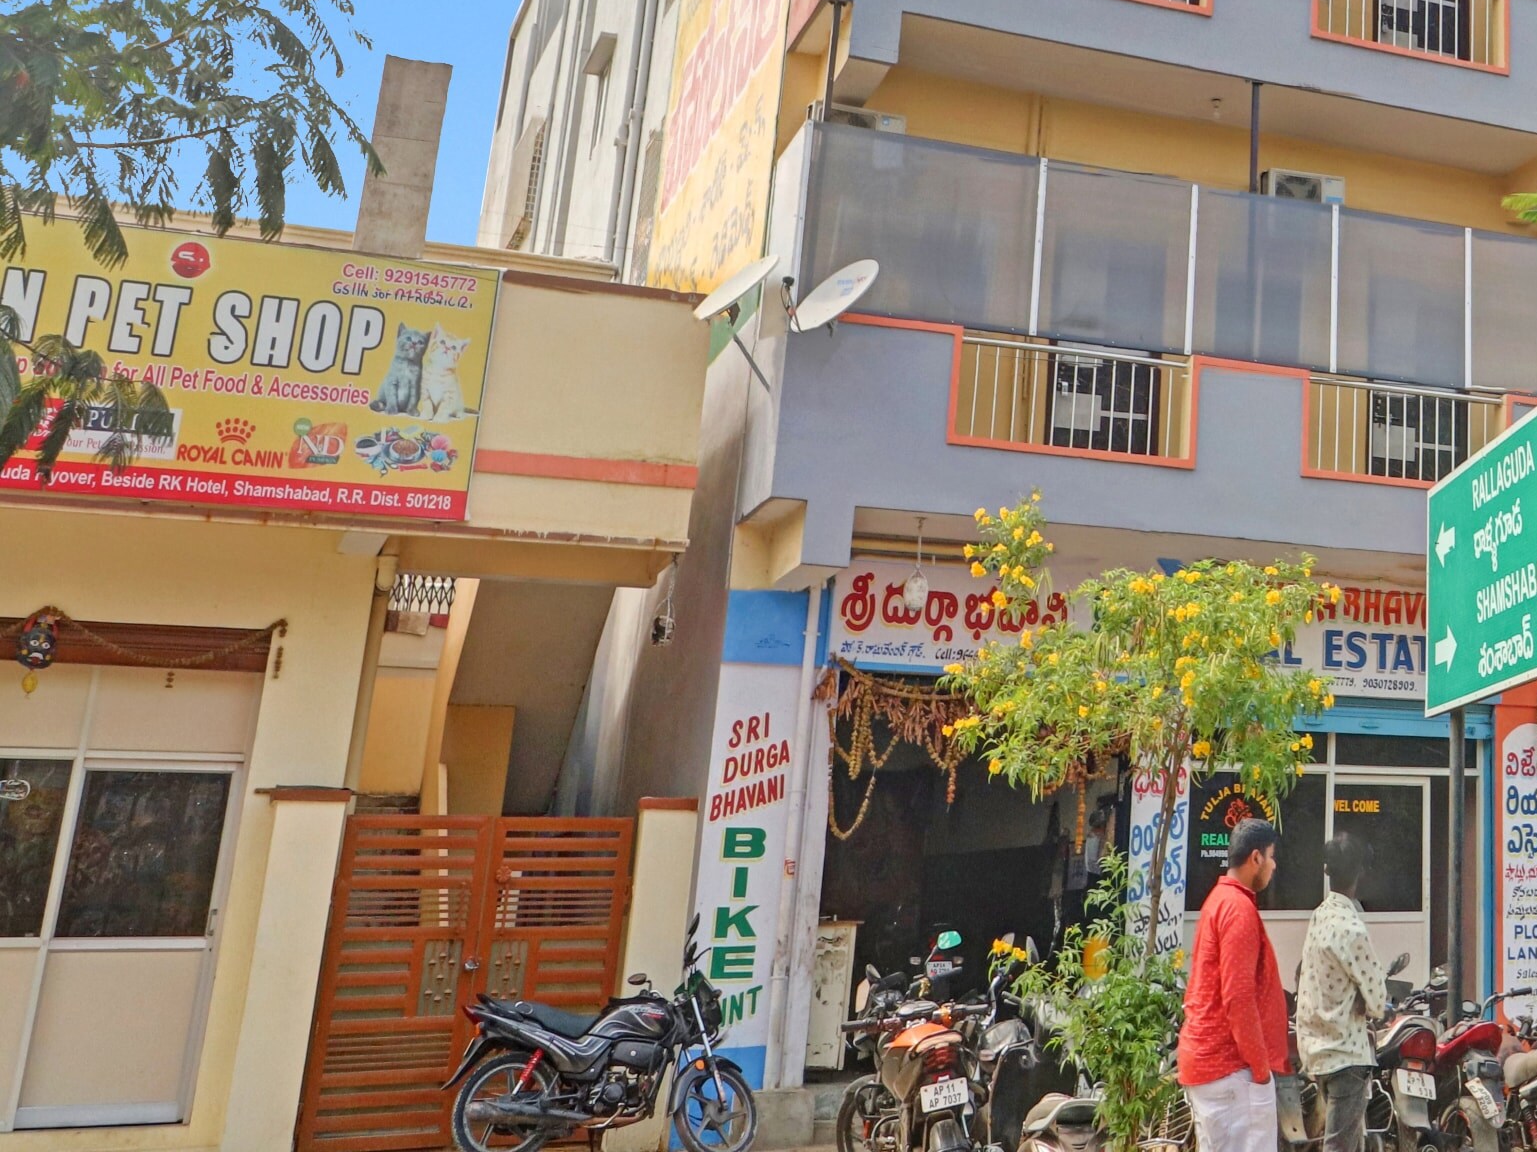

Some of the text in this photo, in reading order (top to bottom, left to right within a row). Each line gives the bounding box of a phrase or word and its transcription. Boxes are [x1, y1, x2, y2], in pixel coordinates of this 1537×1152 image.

[343, 264, 477, 291] Cell: 9291545772
[65, 274, 194, 357] PET
[207, 290, 386, 376] SHOP
[113, 361, 138, 381] for
[140, 364, 164, 388] All
[170, 368, 200, 390] Pet
[202, 370, 248, 395] Food
[251, 376, 265, 396] &
[267, 375, 371, 408] Accessories
[65, 437, 84, 449] our
[176, 444, 284, 469] ROYAL CANIN
[101, 470, 155, 490] Beside
[158, 474, 183, 491] RK
[186, 476, 229, 496] Hotel,
[233, 480, 333, 506] Shamshabad,
[337, 489, 367, 506] R.R.
[370, 491, 402, 508] Dist.
[405, 493, 452, 511] 501218
[1472, 440, 1536, 512] RALLAGUDA
[728, 711, 771, 750] SRI
[721, 739, 791, 785] DURGA
[708, 773, 786, 823] BHAVANI
[1200, 786, 1232, 821] TULJA
[1352, 799, 1381, 813] COME
[1201, 832, 1231, 847] REAL
[929, 1092, 962, 1109] AP 7037
[933, 1083, 956, 1097] AP 11
